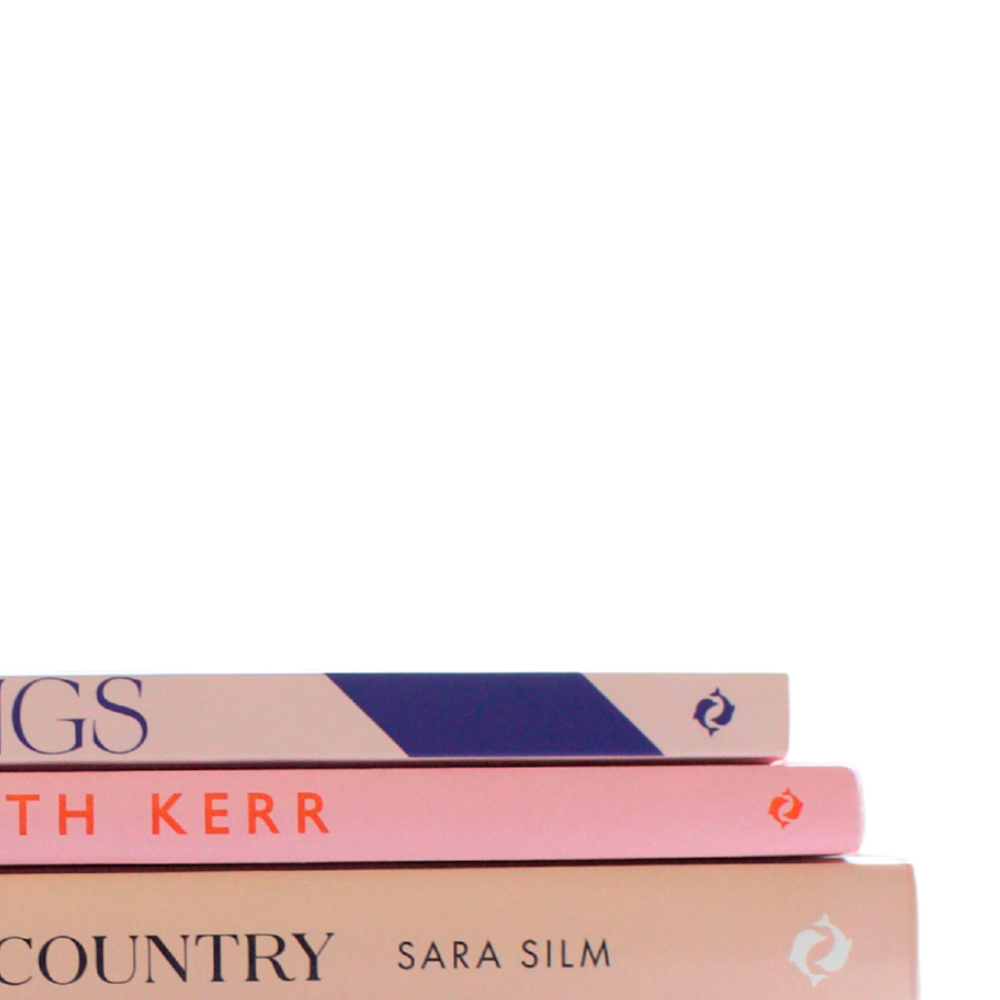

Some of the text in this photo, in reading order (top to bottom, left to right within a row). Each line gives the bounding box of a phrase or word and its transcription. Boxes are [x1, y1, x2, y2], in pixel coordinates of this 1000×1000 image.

[152, 792, 328, 835] KERR
[398, 939, 609, 970] SARA SILM
